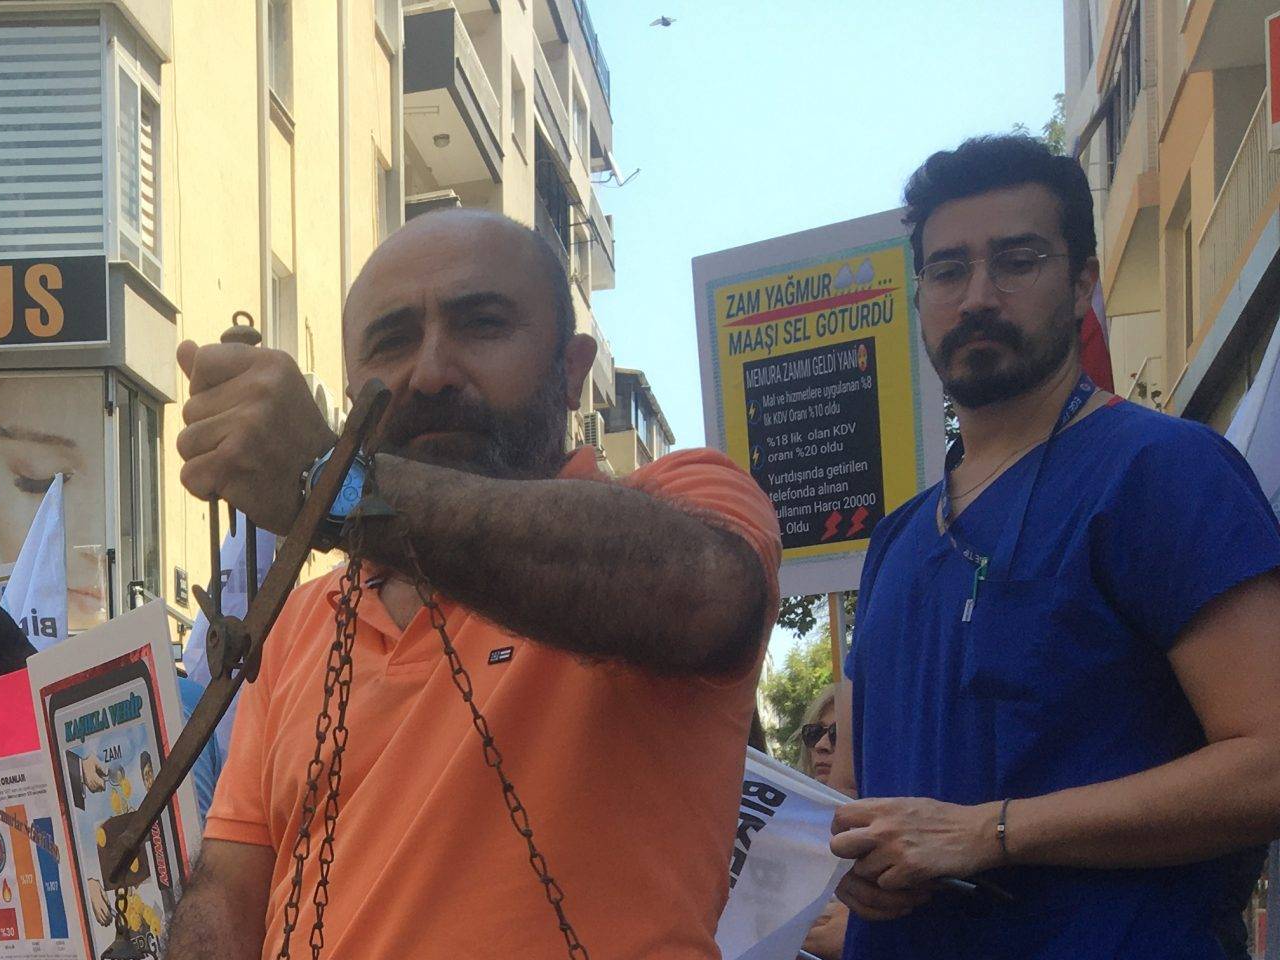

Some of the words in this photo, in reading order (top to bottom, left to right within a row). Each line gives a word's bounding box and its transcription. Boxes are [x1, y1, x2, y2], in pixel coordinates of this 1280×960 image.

[726, 288, 760, 319] ZAM
[765, 273, 832, 312] YAĞMUR
[729, 323, 778, 356] MAAŞI
[783, 318, 811, 344] SEL
[816, 294, 895, 338] GÖTÜRDÜ
[746, 361, 781, 389] MEMURA
[783, 359, 811, 381] ZAMMI
[813, 350, 836, 376] GELDİ
[837, 346, 857, 372] YANİ
[776, 395, 785, 405] ve
[823, 380, 859, 399] uygulanan
[861, 376, 872, 390] %8
[774, 410, 787, 425] KDV
[809, 404, 823, 419] %10
[824, 402, 840, 416] oldu
[767, 434, 788, 448] %18
[791, 432, 802, 443] lik
[808, 426, 830, 441] olan
[833, 422, 856, 436] KDV
[768, 450, 793, 463] oranı
[796, 444, 818, 458] %20
[820, 441, 843, 453] oldu
[768, 466, 823, 486] Yurtdışında
[826, 460, 868, 479] getirilen
[818, 481, 848, 495] alınan
[776, 504, 811, 519] ullanım
[814, 499, 840, 513] Harcı
[844, 493, 876, 509] 20000
[787, 521, 809, 536] Oldu
[103, 745, 122, 763] ZAM
